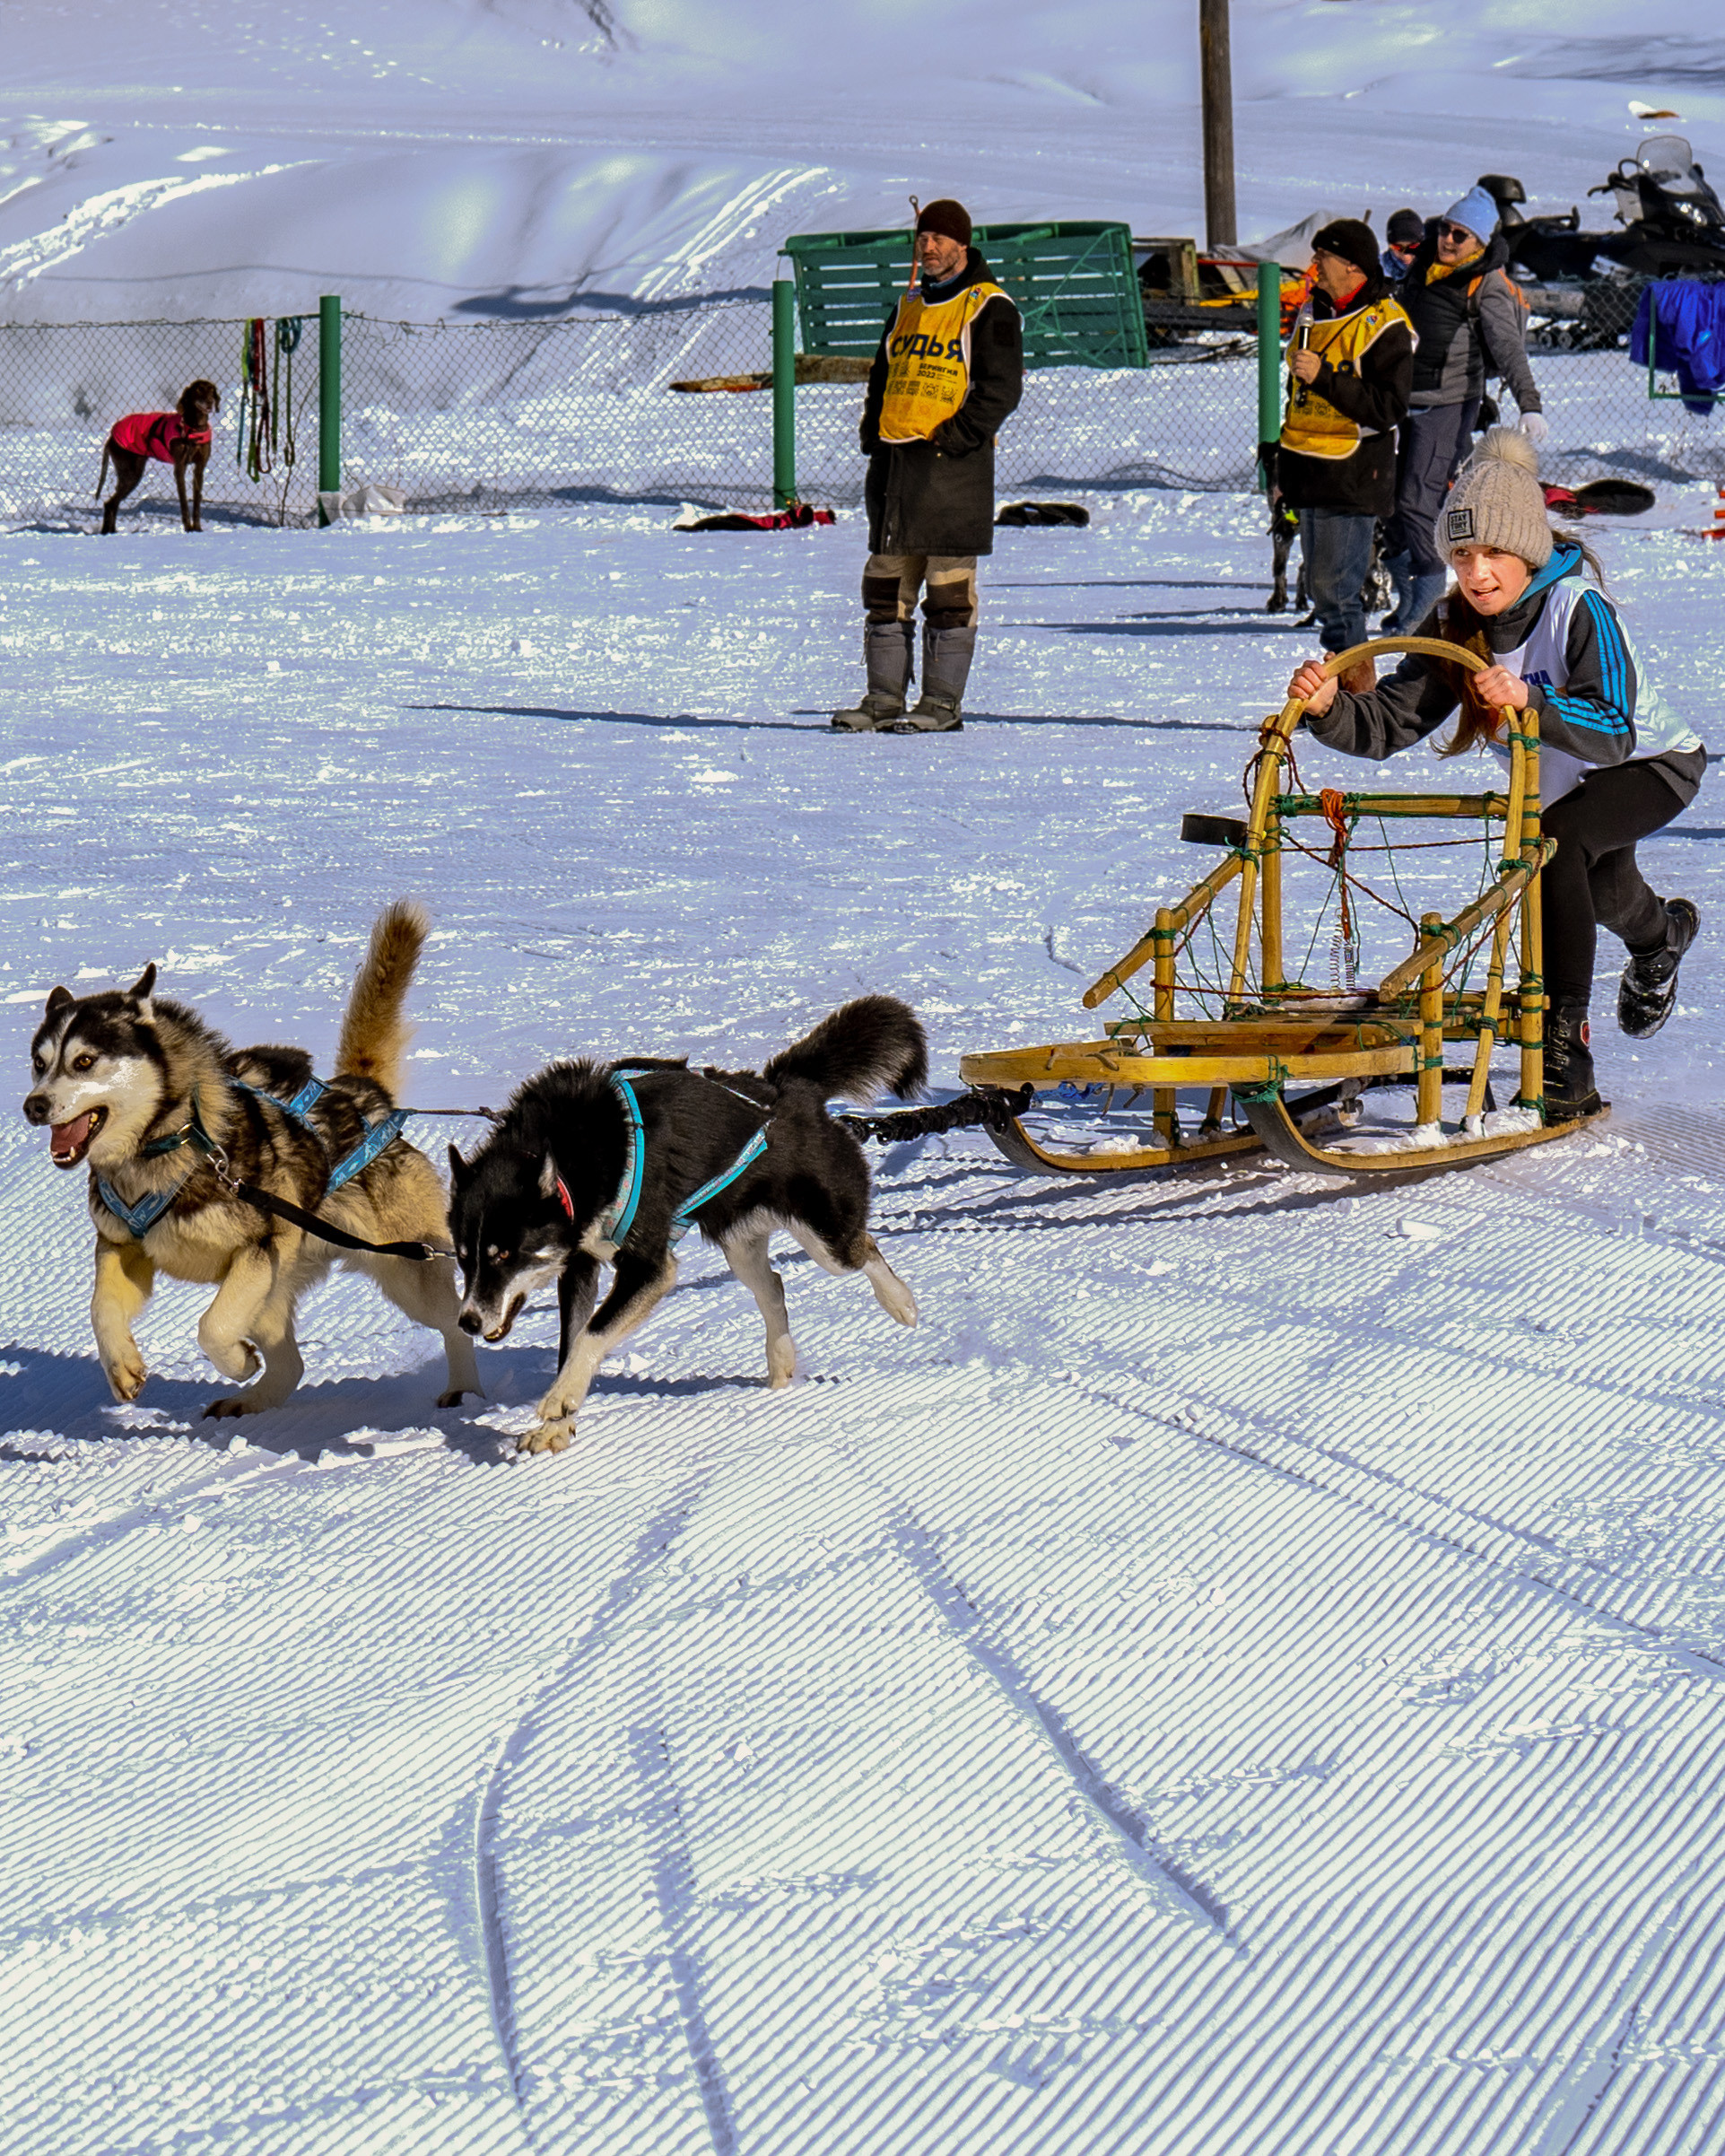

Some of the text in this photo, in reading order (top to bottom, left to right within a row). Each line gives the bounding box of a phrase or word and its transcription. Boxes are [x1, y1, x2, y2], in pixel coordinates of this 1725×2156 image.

[892, 334, 963, 362] СУДЬЯ
[917, 370, 936, 378] 2022
[919, 362, 958, 377] БЕРИНГИЯ
[1451, 512, 1467, 523] STAY
